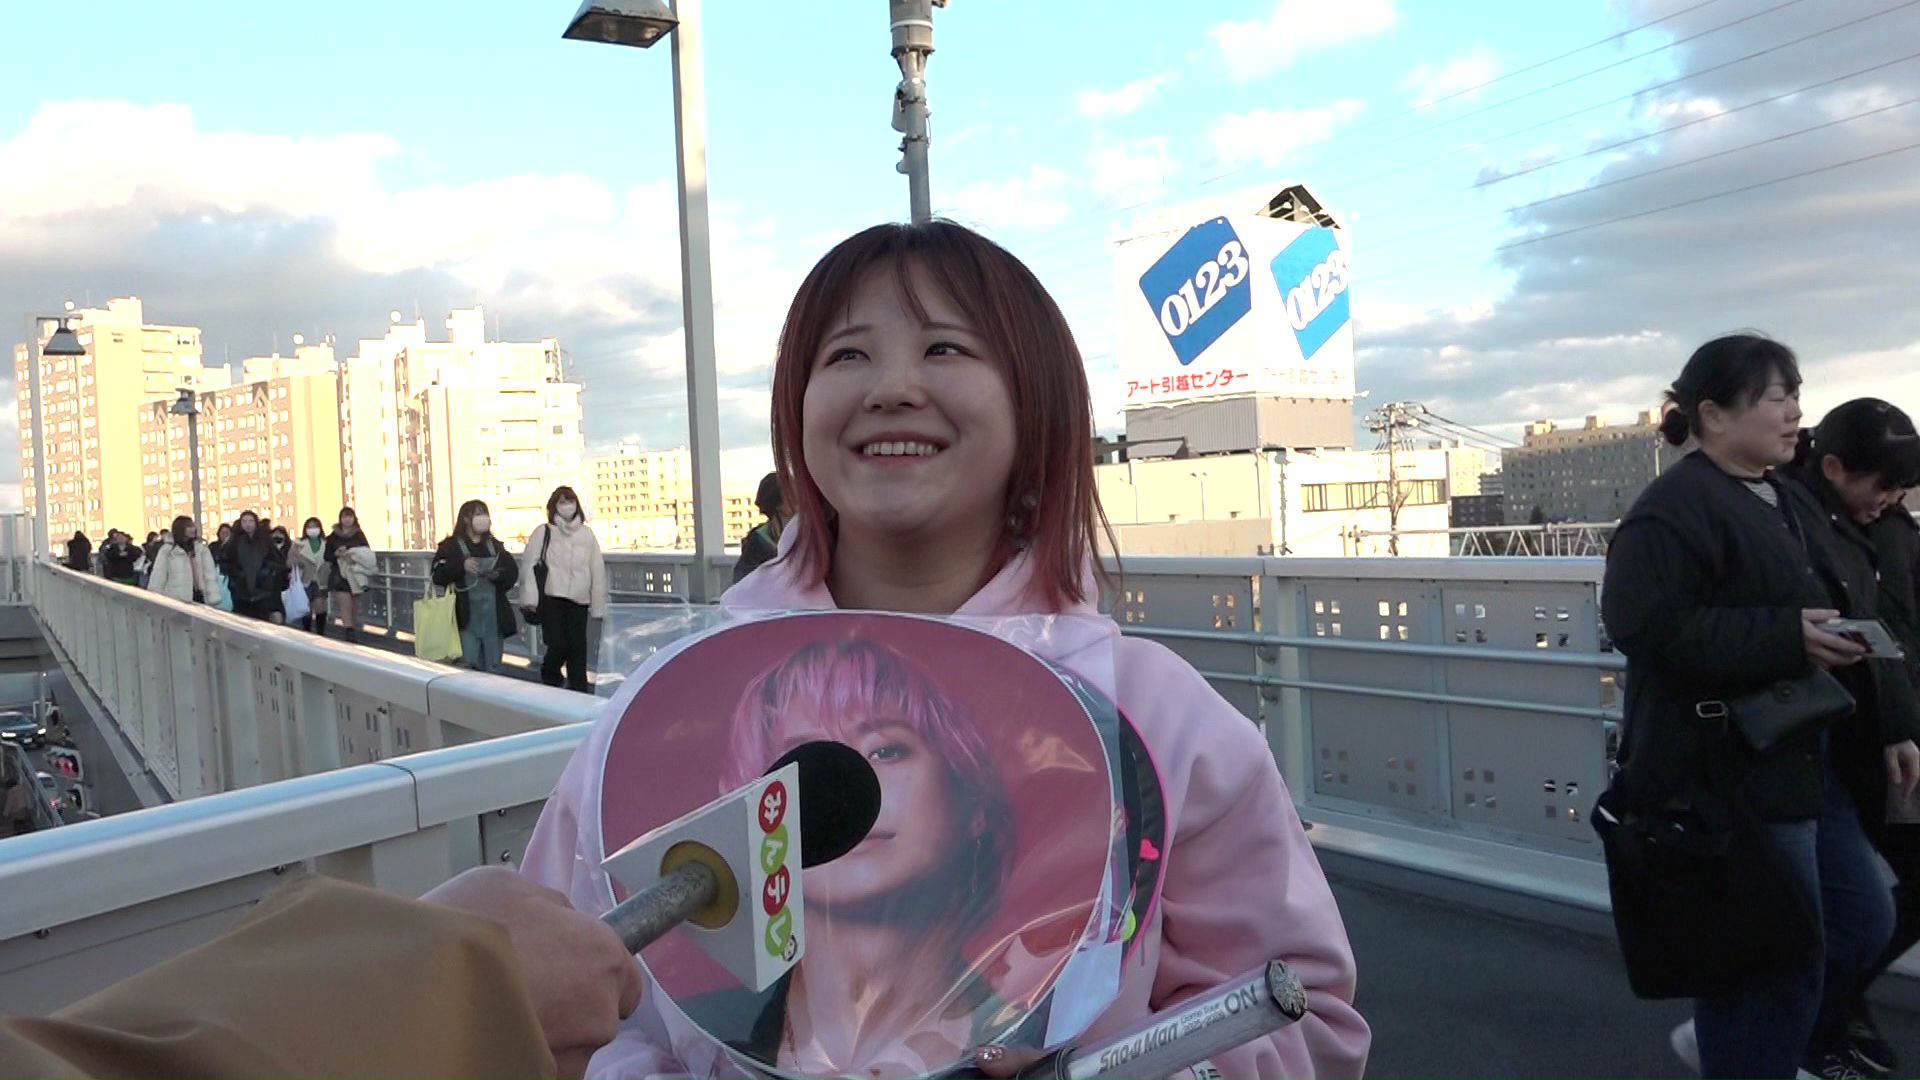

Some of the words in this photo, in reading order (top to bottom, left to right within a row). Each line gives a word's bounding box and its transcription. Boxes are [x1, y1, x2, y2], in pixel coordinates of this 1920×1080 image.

[1160, 240, 1249, 336] 0123
[1286, 249, 1349, 331] 0123
[1127, 369, 1249, 397] アート引越センター
[761, 787, 788, 949] みんテレ
[1143, 1023, 1179, 1055] Man
[1224, 983, 1259, 1014] ON
